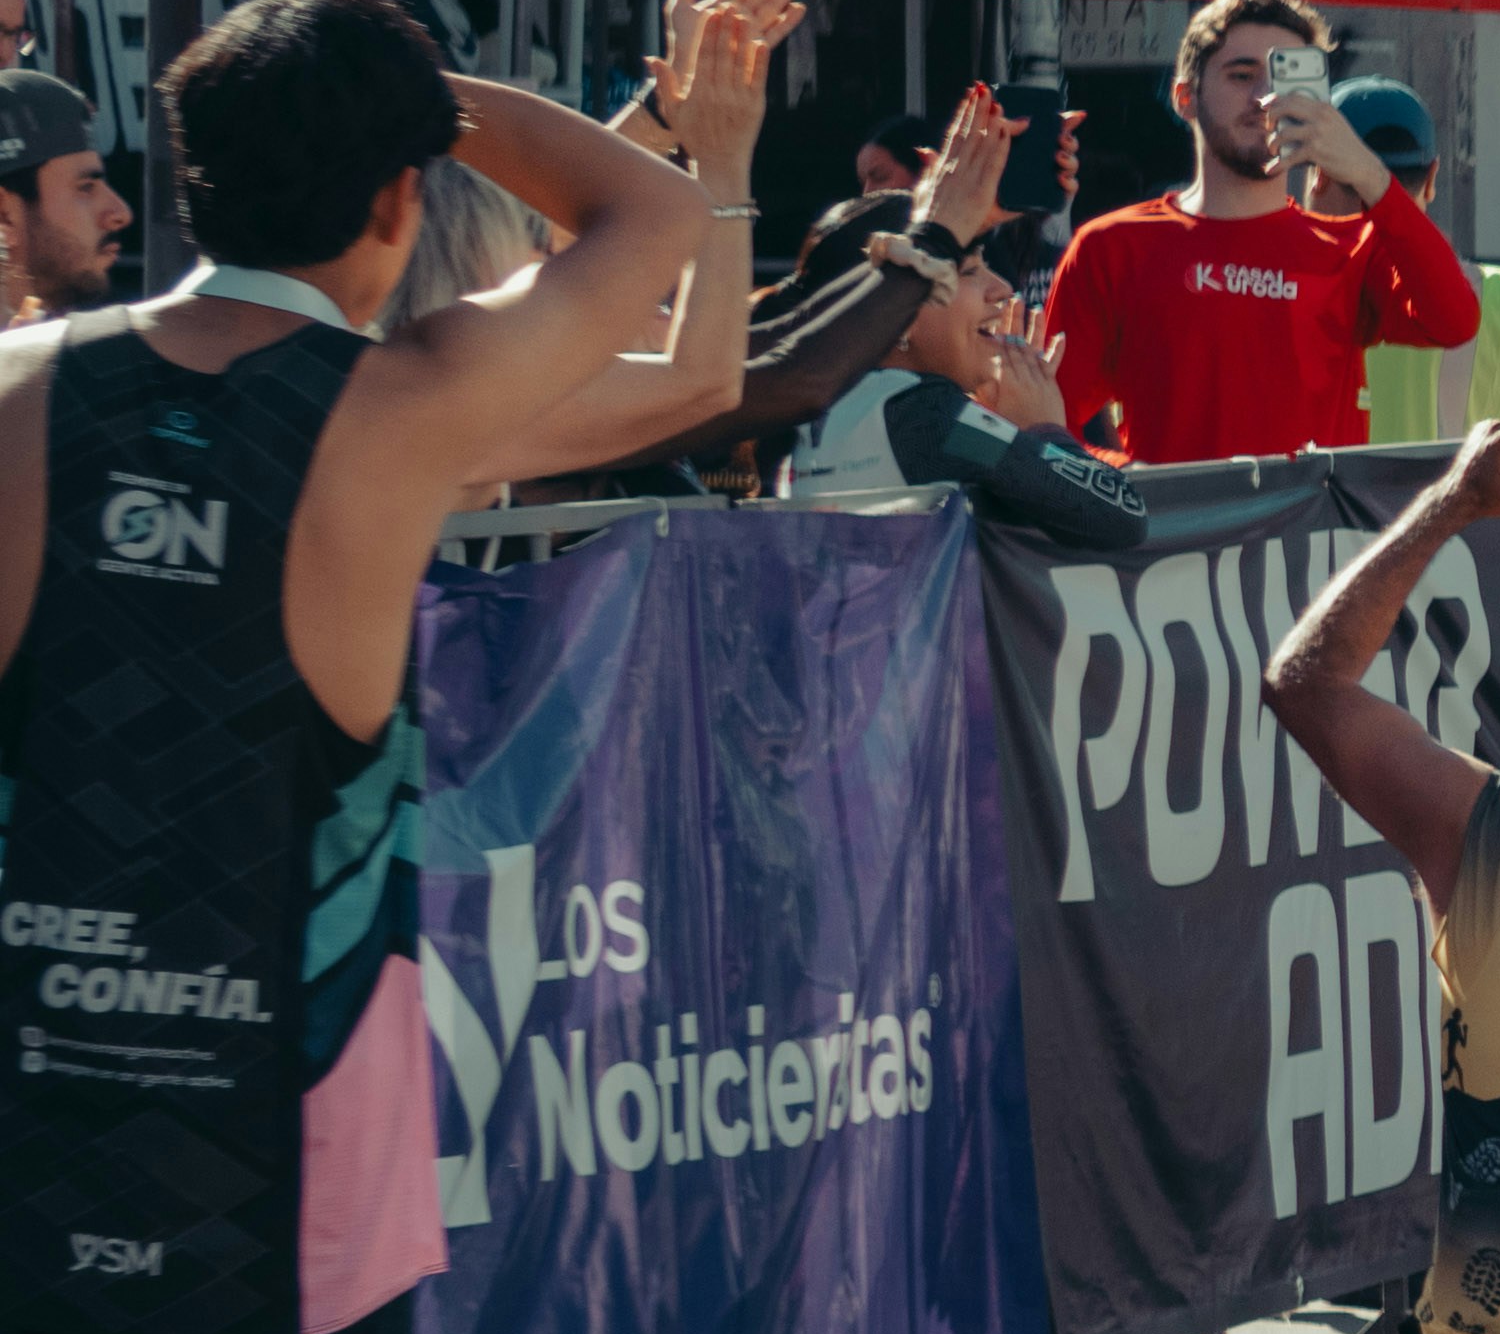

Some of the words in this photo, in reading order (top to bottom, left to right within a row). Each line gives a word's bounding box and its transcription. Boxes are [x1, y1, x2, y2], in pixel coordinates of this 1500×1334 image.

[102, 490, 229, 570] ON
[0, 901, 149, 964] CREE,
[40, 963, 274, 1024] CONFÍA.
[1266, 869, 1444, 1220] AD
